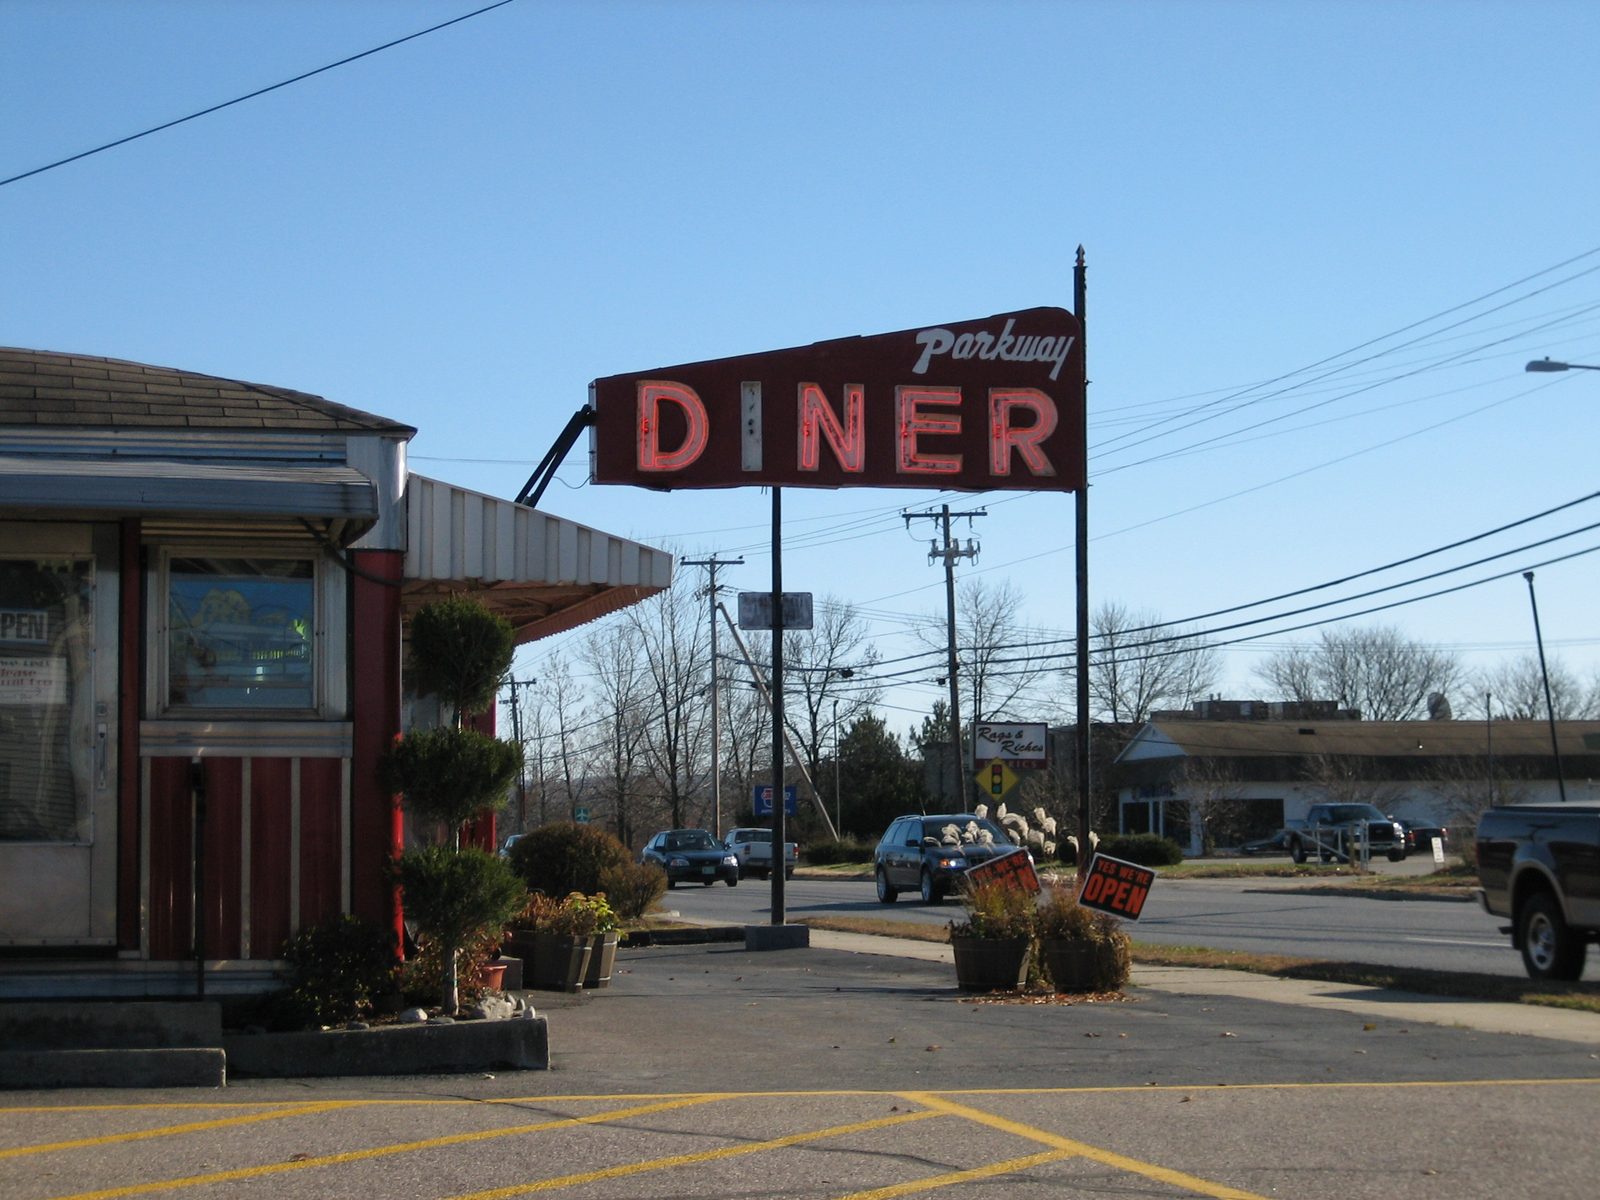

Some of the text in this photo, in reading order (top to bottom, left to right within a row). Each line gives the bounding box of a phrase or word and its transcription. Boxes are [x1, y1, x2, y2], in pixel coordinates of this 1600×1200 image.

[912, 318, 1075, 381] Parkway
[636, 378, 1060, 478] DINER
[0, 612, 47, 640] PEN
[978, 726, 1012, 743] Rags
[1001, 740, 1044, 756] Riches
[1099, 859, 1151, 886] YES WE'RE
[1083, 873, 1148, 915] OPEN
